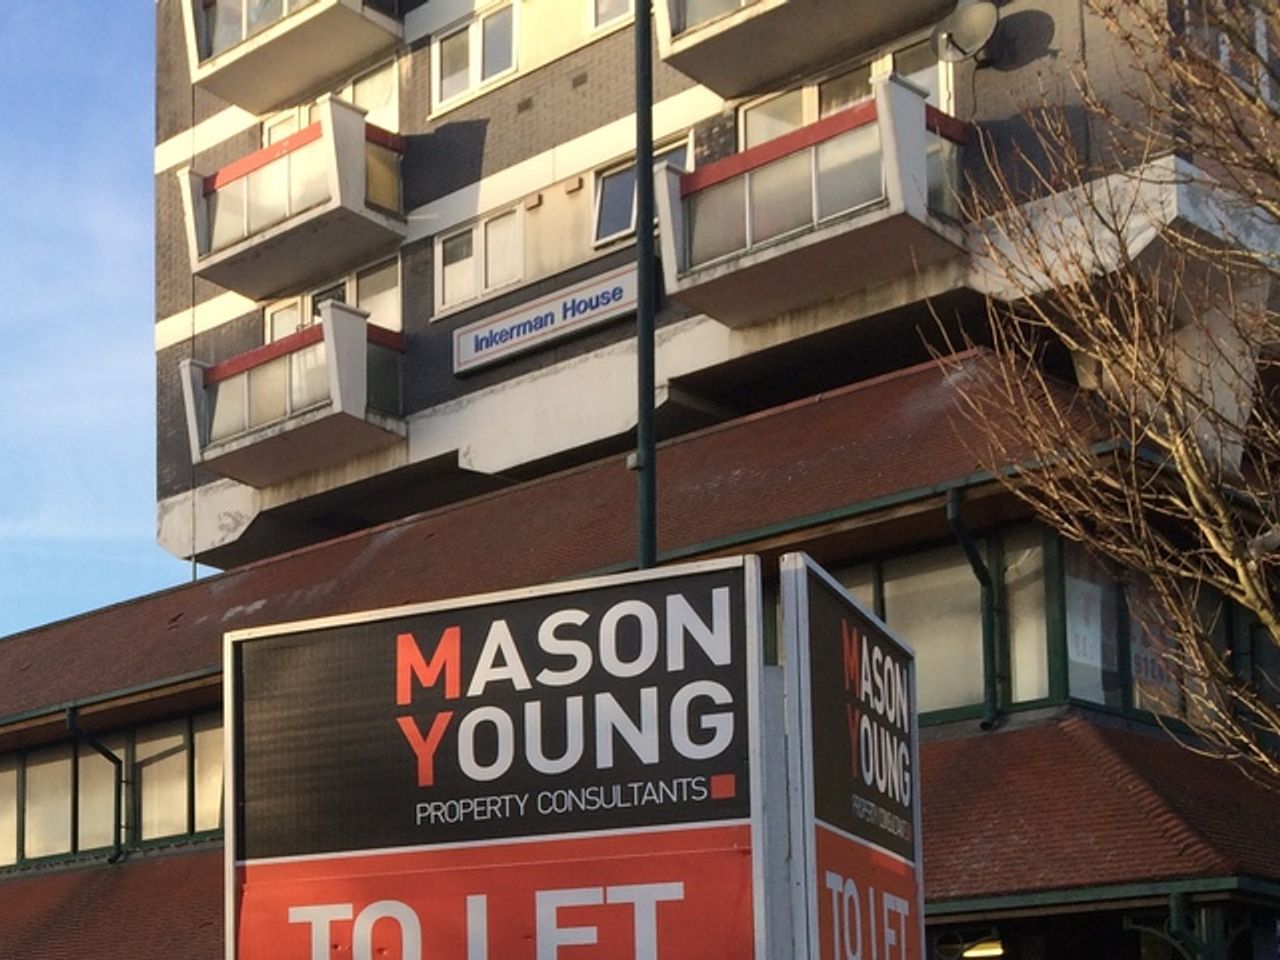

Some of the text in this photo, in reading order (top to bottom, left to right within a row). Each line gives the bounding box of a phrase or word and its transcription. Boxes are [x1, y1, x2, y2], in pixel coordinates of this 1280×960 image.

[474, 285, 624, 353] Inkerman House
[396, 587, 732, 706] MASON
[842, 619, 909, 734] MASON
[396, 681, 735, 787] YOUNG
[846, 703, 911, 807] YOUNG
[416, 776, 708, 826] PROPERTY CONSULTANTS
